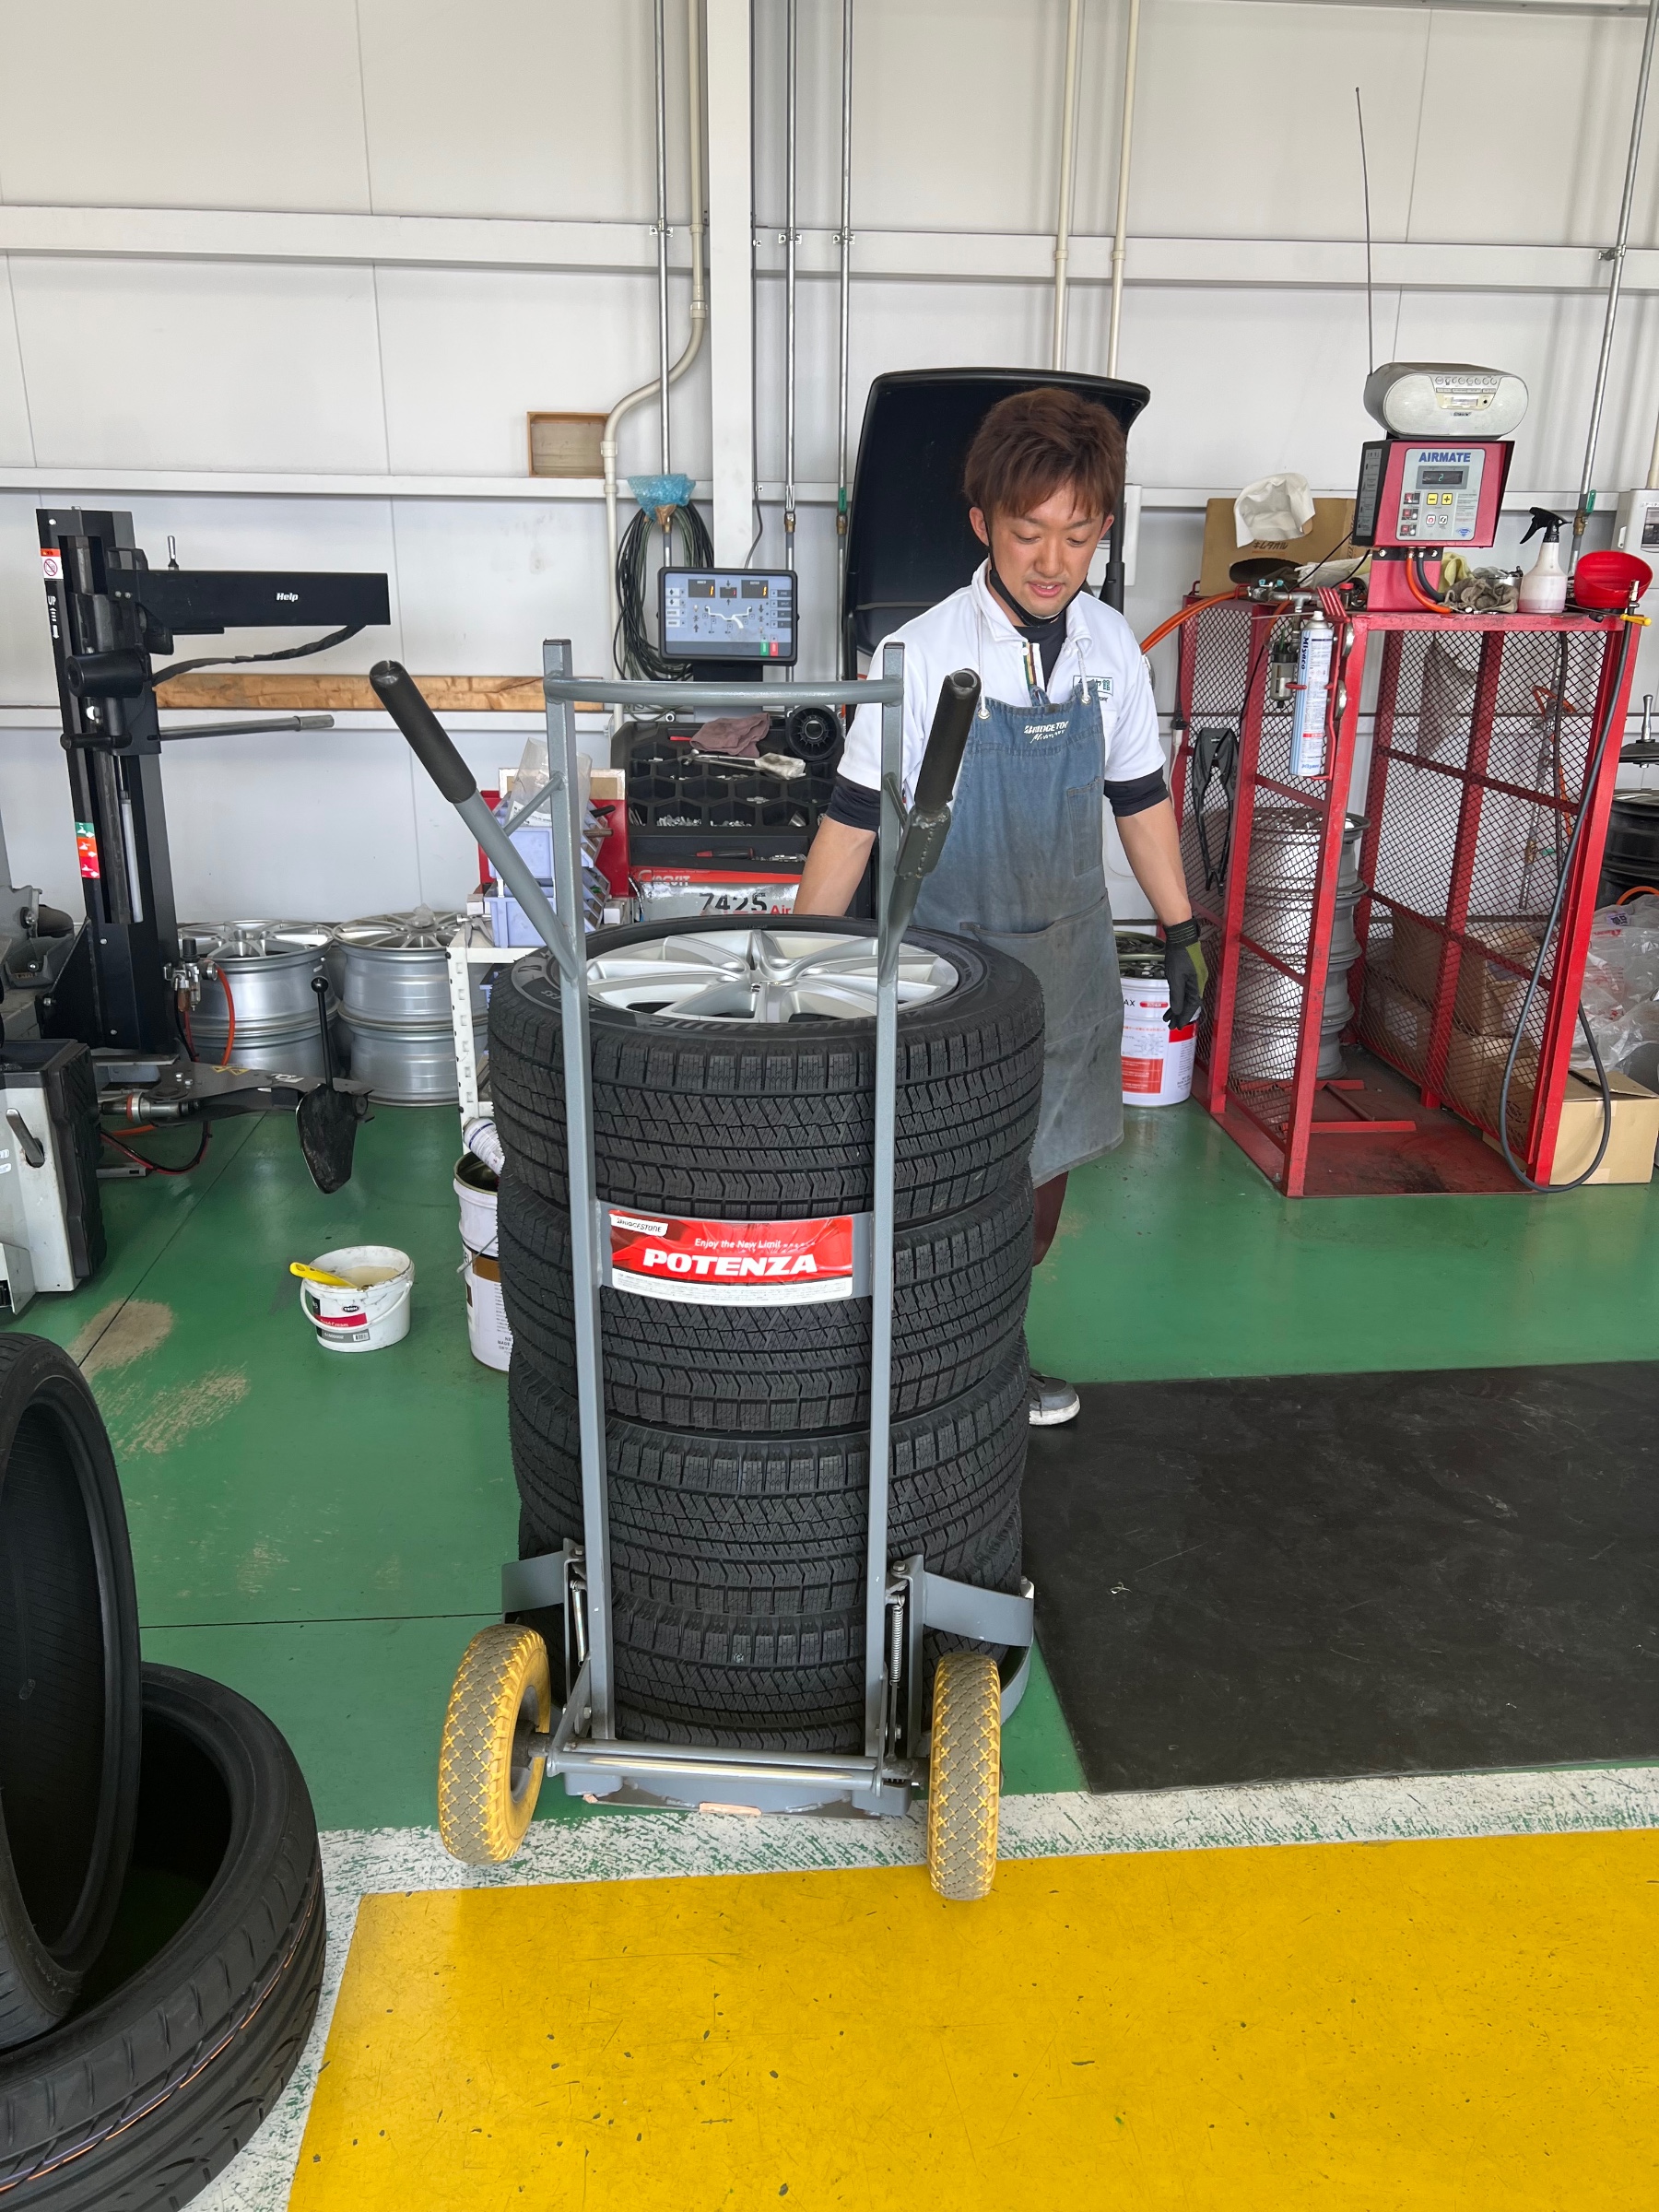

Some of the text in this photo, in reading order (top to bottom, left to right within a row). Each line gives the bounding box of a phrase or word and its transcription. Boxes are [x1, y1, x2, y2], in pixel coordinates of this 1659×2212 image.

[1418, 452, 1471, 462] AIRMATE
[1438, 473, 1444, 482] 2
[1253, 540, 1289, 550] キムタオル
[47, 595, 56, 606] UP
[276, 592, 299, 603] Help
[700, 892, 792, 915] 7425 Air
[694, 1238, 782, 1250] Enjoy the New Limit
[642, 1249, 818, 1276] POTENZA
